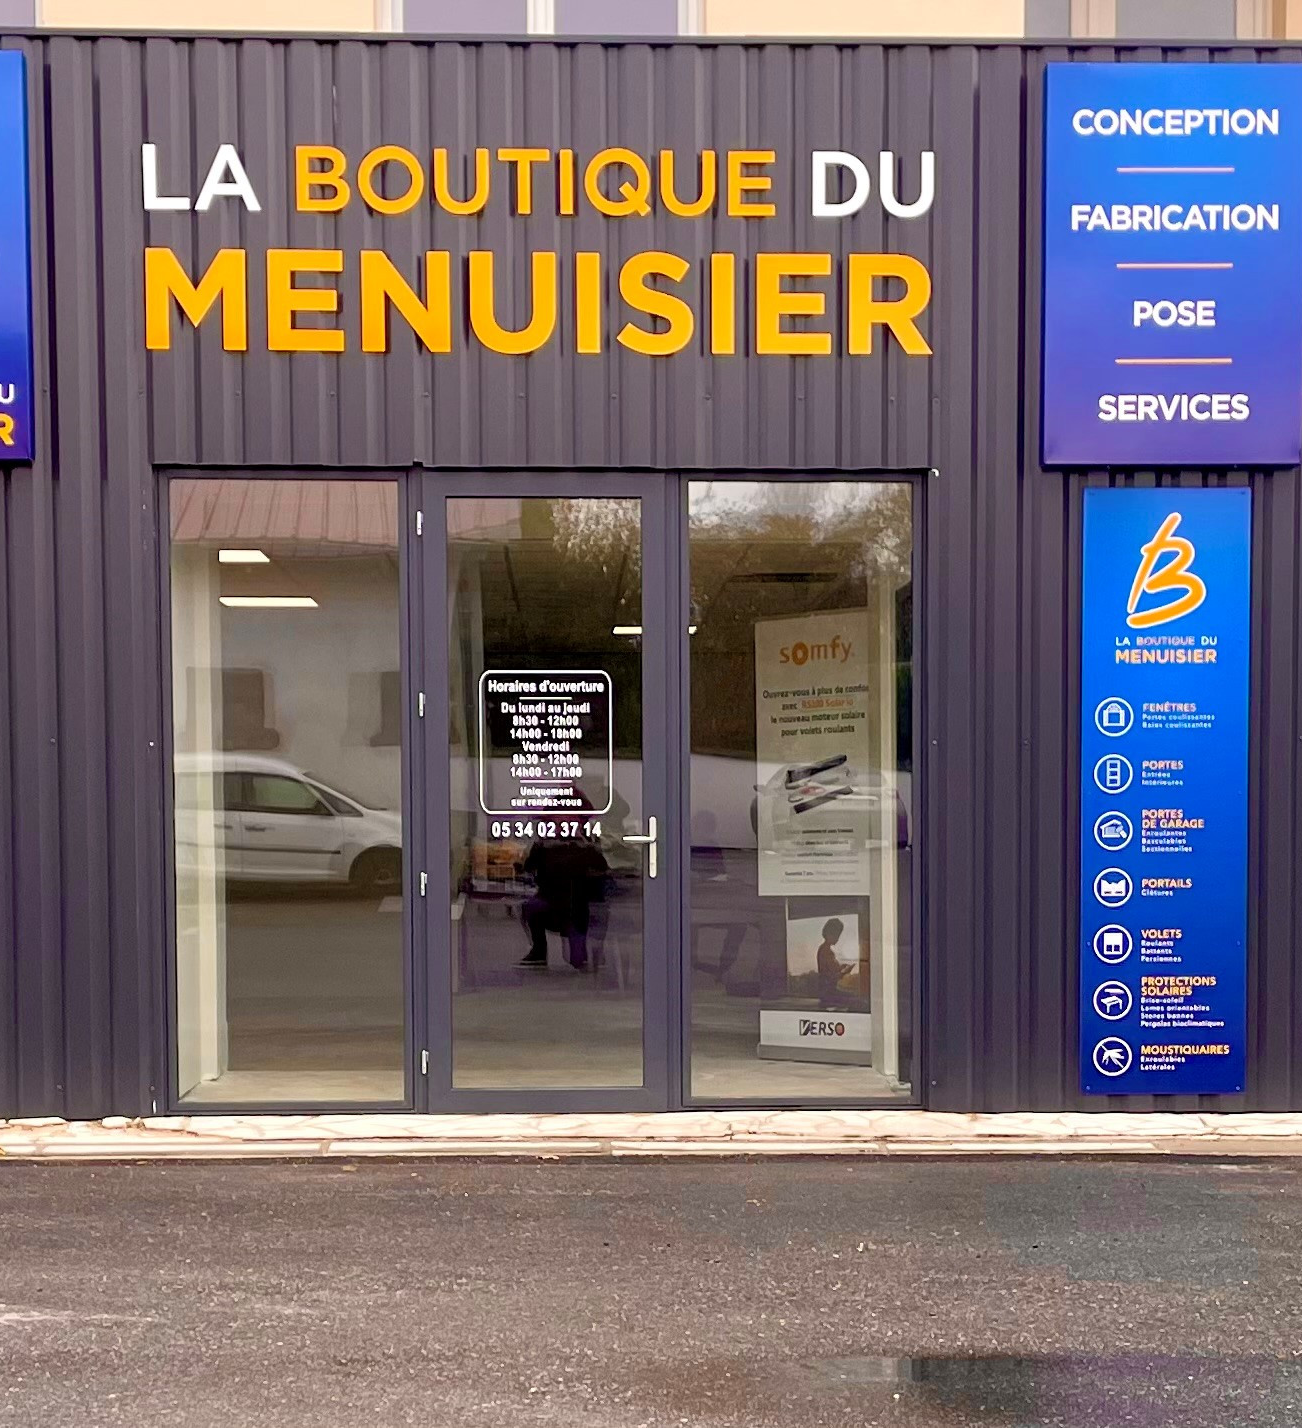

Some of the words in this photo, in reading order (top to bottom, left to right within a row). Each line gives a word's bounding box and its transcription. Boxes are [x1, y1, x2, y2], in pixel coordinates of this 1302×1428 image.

[1072, 108, 1279, 135] CONCEPTION
[141, 143, 261, 212] LA
[295, 145, 775, 217] BOUTIQUE
[812, 150, 935, 218] DU
[1071, 204, 1279, 231] FABRICATION
[144, 247, 933, 355] MENUISIER
[1133, 300, 1216, 327] POSE
[1097, 394, 1250, 421] SERVICES
[1115, 636, 1131, 646] LA
[1136, 635, 1195, 646] BOUTIQUE
[1201, 635, 1217, 646] DU
[779, 634, 852, 666] somfy
[1115, 649, 1217, 664] MENUISIER
[488, 680, 537, 693] Horaires
[539, 680, 605, 693] d'ouverture
[817, 687, 832, 696] plus
[834, 686, 844, 694] de
[501, 702, 516, 713] Du
[518, 702, 546, 713] lundi
[548, 705, 561, 713] au
[563, 702, 591, 715] jeudi
[782, 703, 797, 711] avec
[1142, 701, 1197, 712] FENÊTRES
[512, 715, 538, 726] 8h30
[548, 715, 579, 726] 12h00
[770, 715, 777, 724] le
[812, 713, 839, 721] moteur
[841, 710, 865, 719] solaire
[510, 728, 542, 739] 14h00
[551, 728, 582, 739] 18h00
[781, 729, 797, 738] pour
[800, 726, 822, 735] volets
[824, 724, 855, 733] roulants
[522, 741, 570, 752] Vendredi
[512, 754, 538, 764] 8h30
[548, 754, 579, 764] 12h00
[1142, 760, 1184, 770] PORTES
[510, 767, 542, 777] 14h00
[551, 767, 582, 777] 17h00
[520, 787, 573, 797] Uniquement
[511, 799, 527, 807] sur
[528, 798, 582, 807] rendez-vous
[1141, 809, 1184, 819] PORTES
[1141, 819, 1157, 828] DE
[1159, 819, 1205, 828] GARAGE
[491, 822, 511, 837] 05
[514, 822, 533, 837] 34
[537, 822, 556, 837] 02
[560, 822, 578, 837] 37
[584, 822, 602, 837] 14
[1141, 878, 1193, 888] PORTAILS
[1141, 929, 1183, 939] VOLETS
[1141, 976, 1217, 986] PROTECTIONS
[1141, 986, 1193, 996] SOLAIRES
[799, 1019, 845, 1036] VERSO
[1141, 1045, 1230, 1055] MOUSTIQUAIRES
